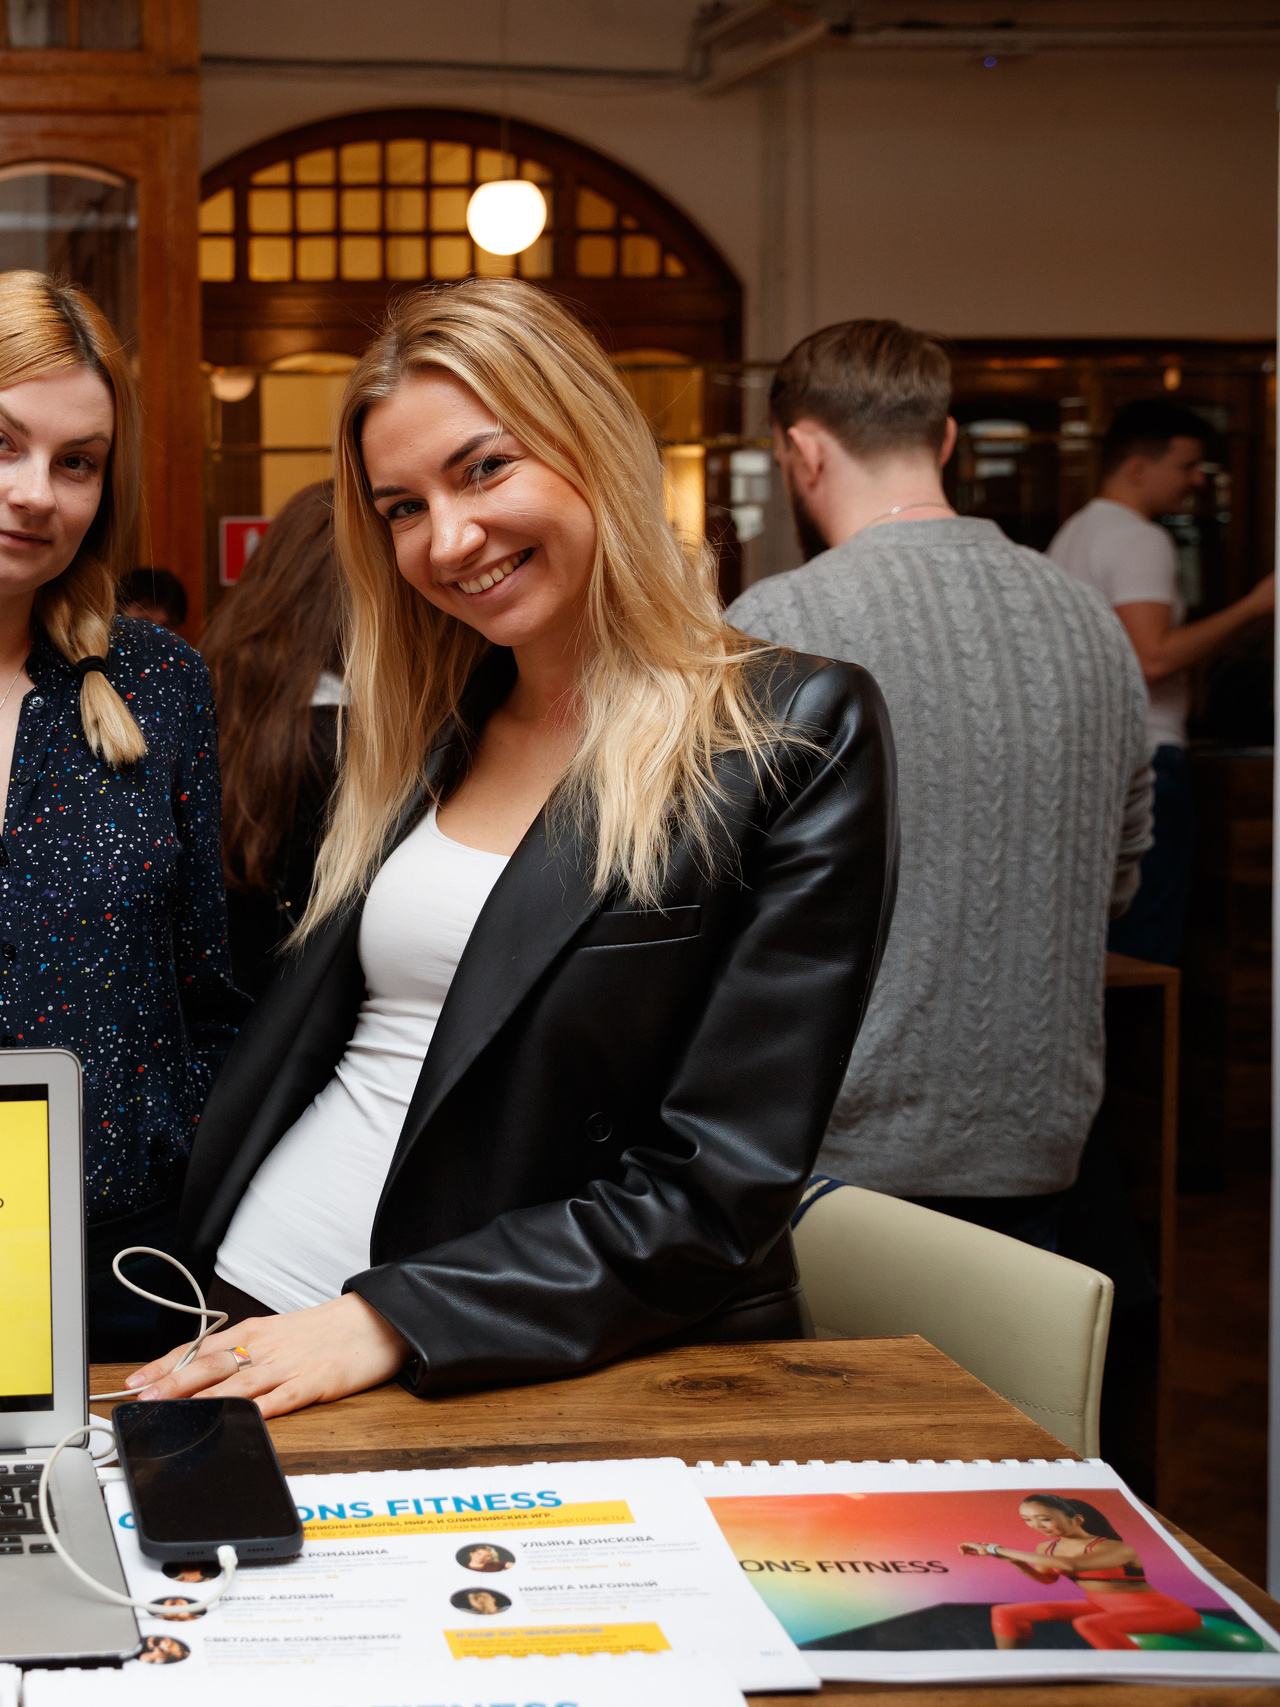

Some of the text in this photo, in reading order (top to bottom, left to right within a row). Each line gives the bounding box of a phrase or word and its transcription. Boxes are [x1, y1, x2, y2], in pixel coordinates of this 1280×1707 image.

[387, 1491, 562, 1517] FITNESS
[579, 1536, 654, 1546] ДОНСКОВА
[308, 1549, 389, 1558] РОМАШИНА
[739, 1560, 949, 1573] ONS FITNESS
[519, 1580, 658, 1592] НИКИТА НАГОРНЫЙ
